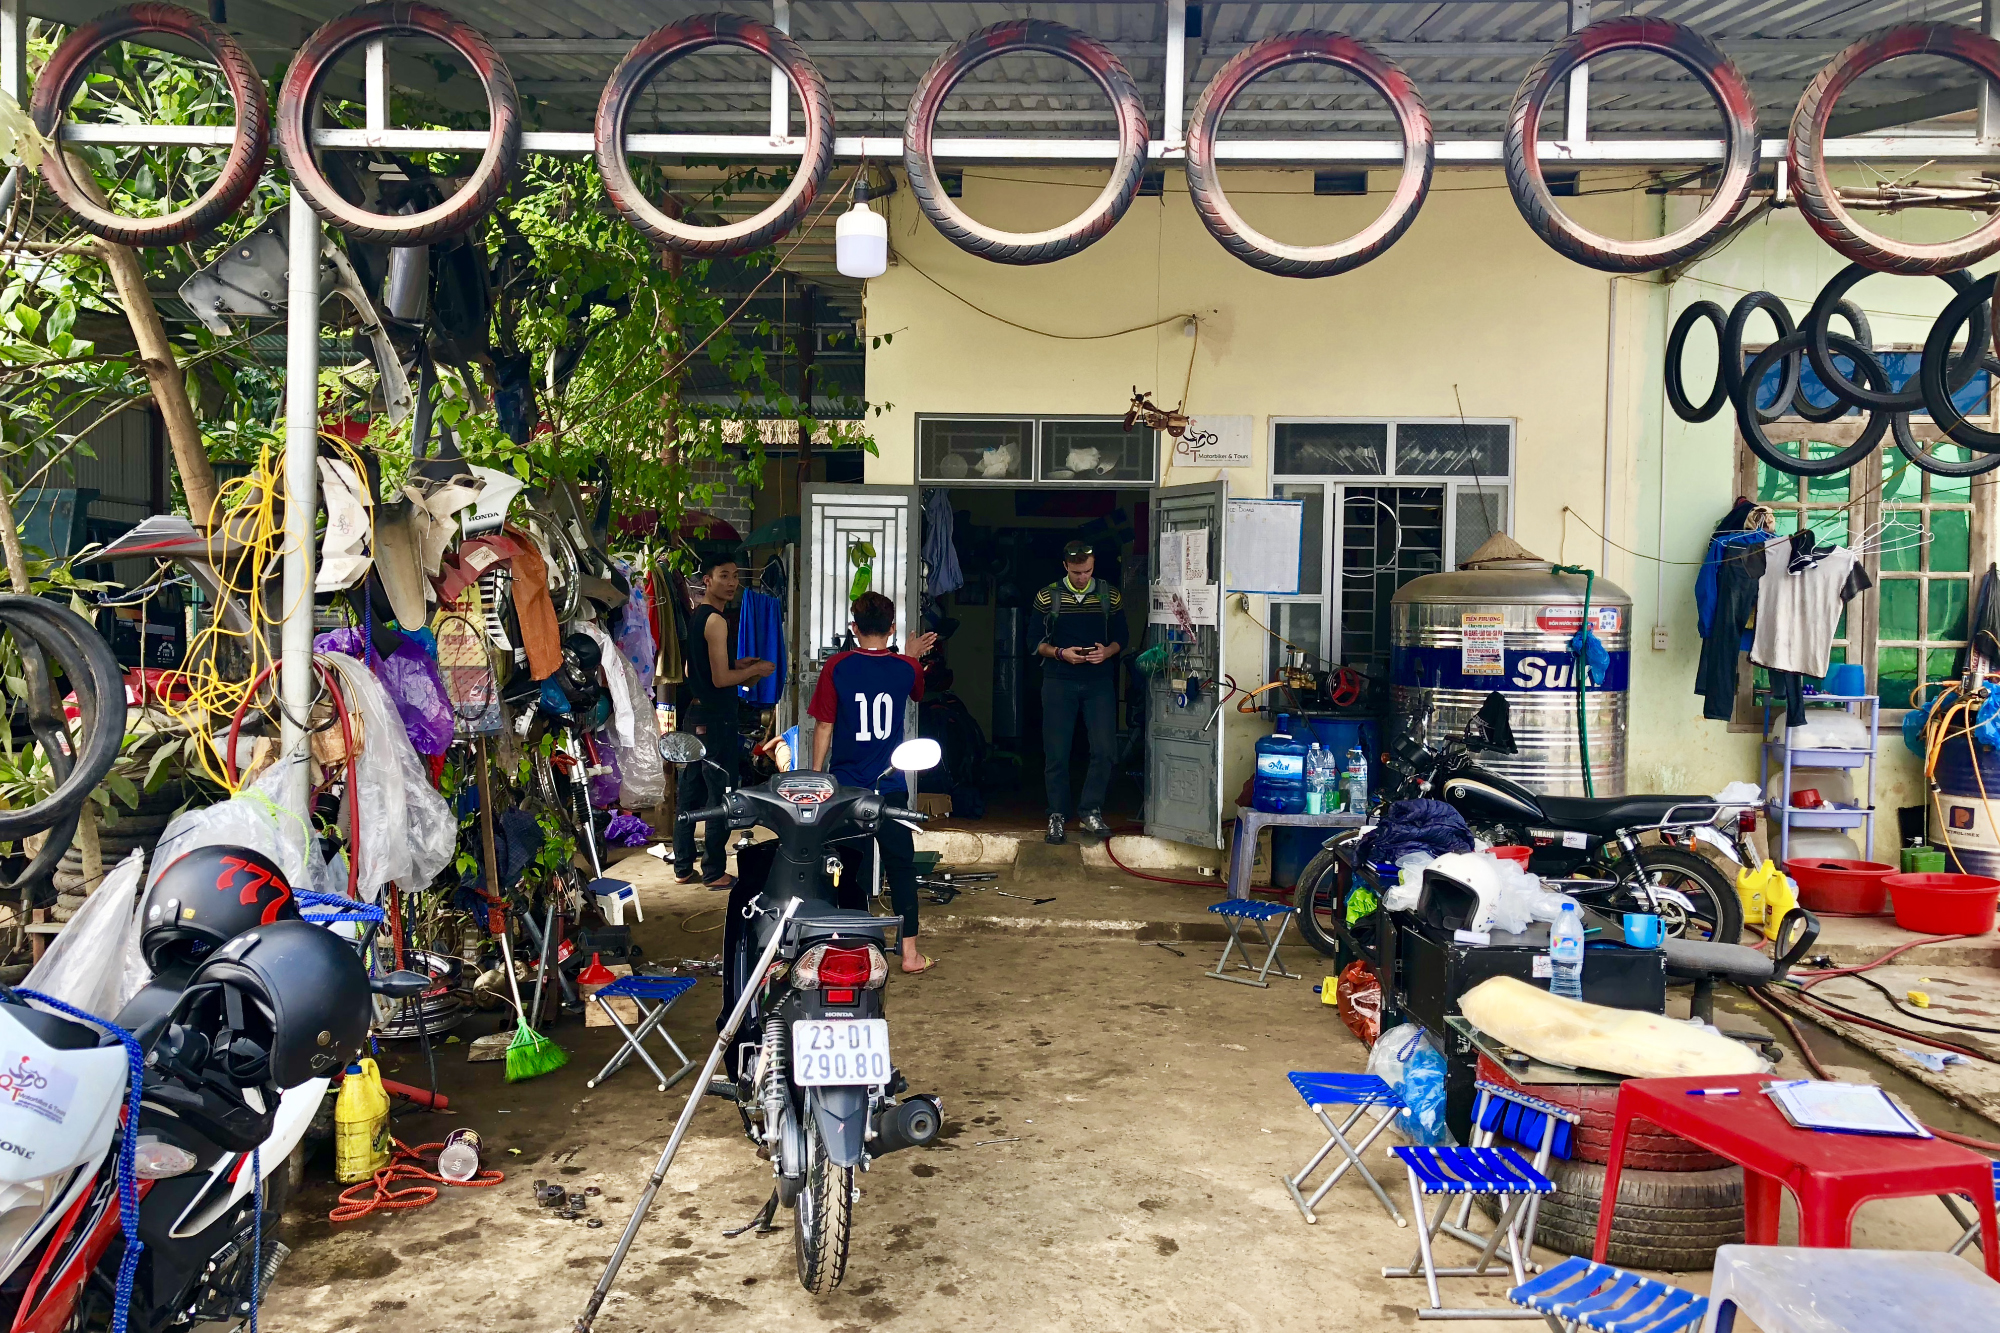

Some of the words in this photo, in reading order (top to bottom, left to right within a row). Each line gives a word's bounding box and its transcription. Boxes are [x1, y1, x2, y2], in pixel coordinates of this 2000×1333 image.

[468, 511, 500, 522] HONDA
[1511, 656, 1602, 688] Suk
[854, 692, 893, 741] 10
[1530, 829, 1555, 839] YAMAHA
[1946, 829, 1980, 838] ETROLIMEX
[216, 855, 290, 926] 777
[801, 1052, 884, 1080] 290.80
